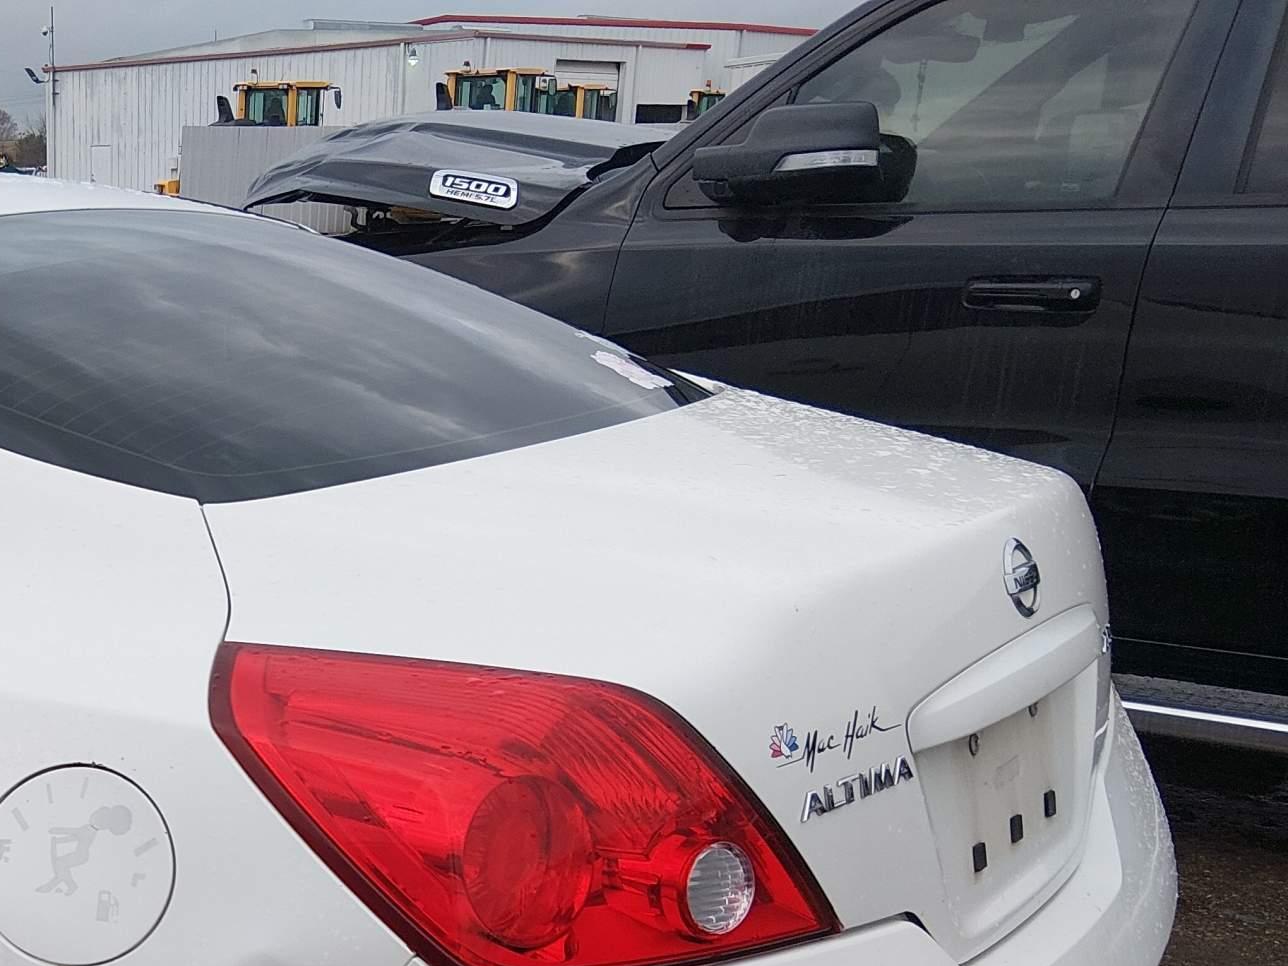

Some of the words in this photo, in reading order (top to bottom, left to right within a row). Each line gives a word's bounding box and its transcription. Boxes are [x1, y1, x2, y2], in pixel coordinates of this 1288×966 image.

[445, 176, 508, 196] 1500
[777, 731, 841, 773] Mac
[843, 706, 902, 760] Haik
[800, 754, 914, 823] ALTIMA
